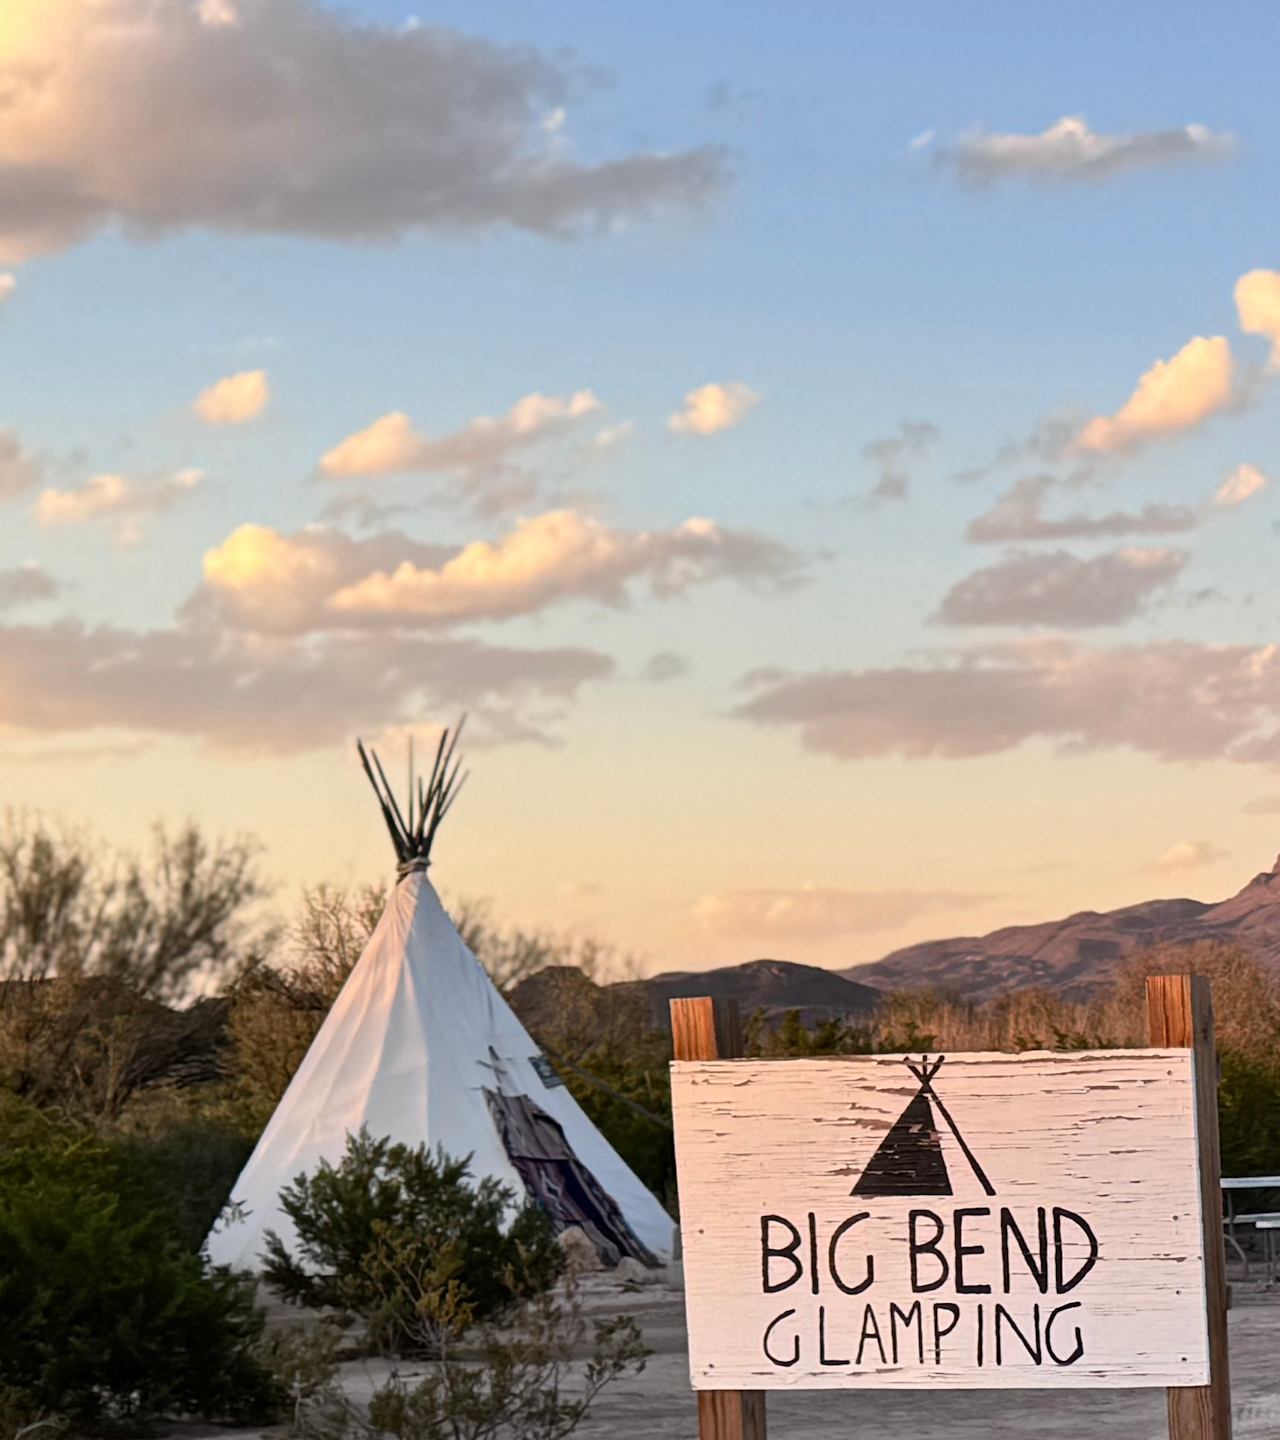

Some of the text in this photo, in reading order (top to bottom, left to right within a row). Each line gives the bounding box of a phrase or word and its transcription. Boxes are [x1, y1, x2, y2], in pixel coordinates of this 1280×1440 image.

[760, 1206, 1098, 1295] BIG BEND
[763, 1300, 1083, 1367] GLAMPING
